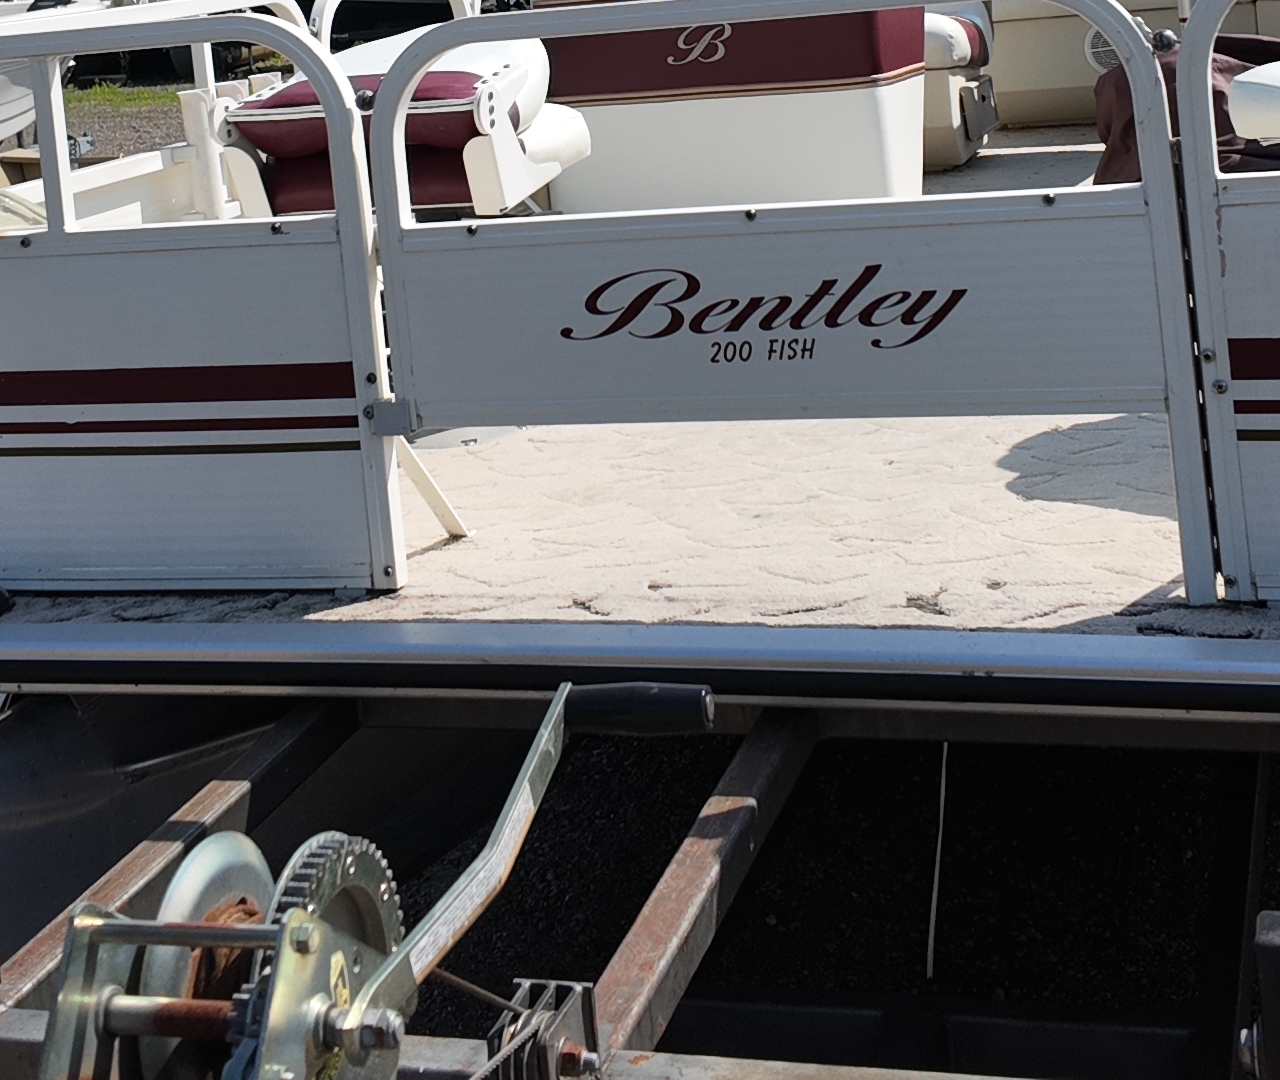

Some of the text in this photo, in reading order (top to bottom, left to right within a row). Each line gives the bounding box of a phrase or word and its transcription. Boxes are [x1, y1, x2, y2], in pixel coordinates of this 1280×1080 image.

[559, 263, 968, 349] Bentley
[709, 337, 815, 363] 200 FISH
